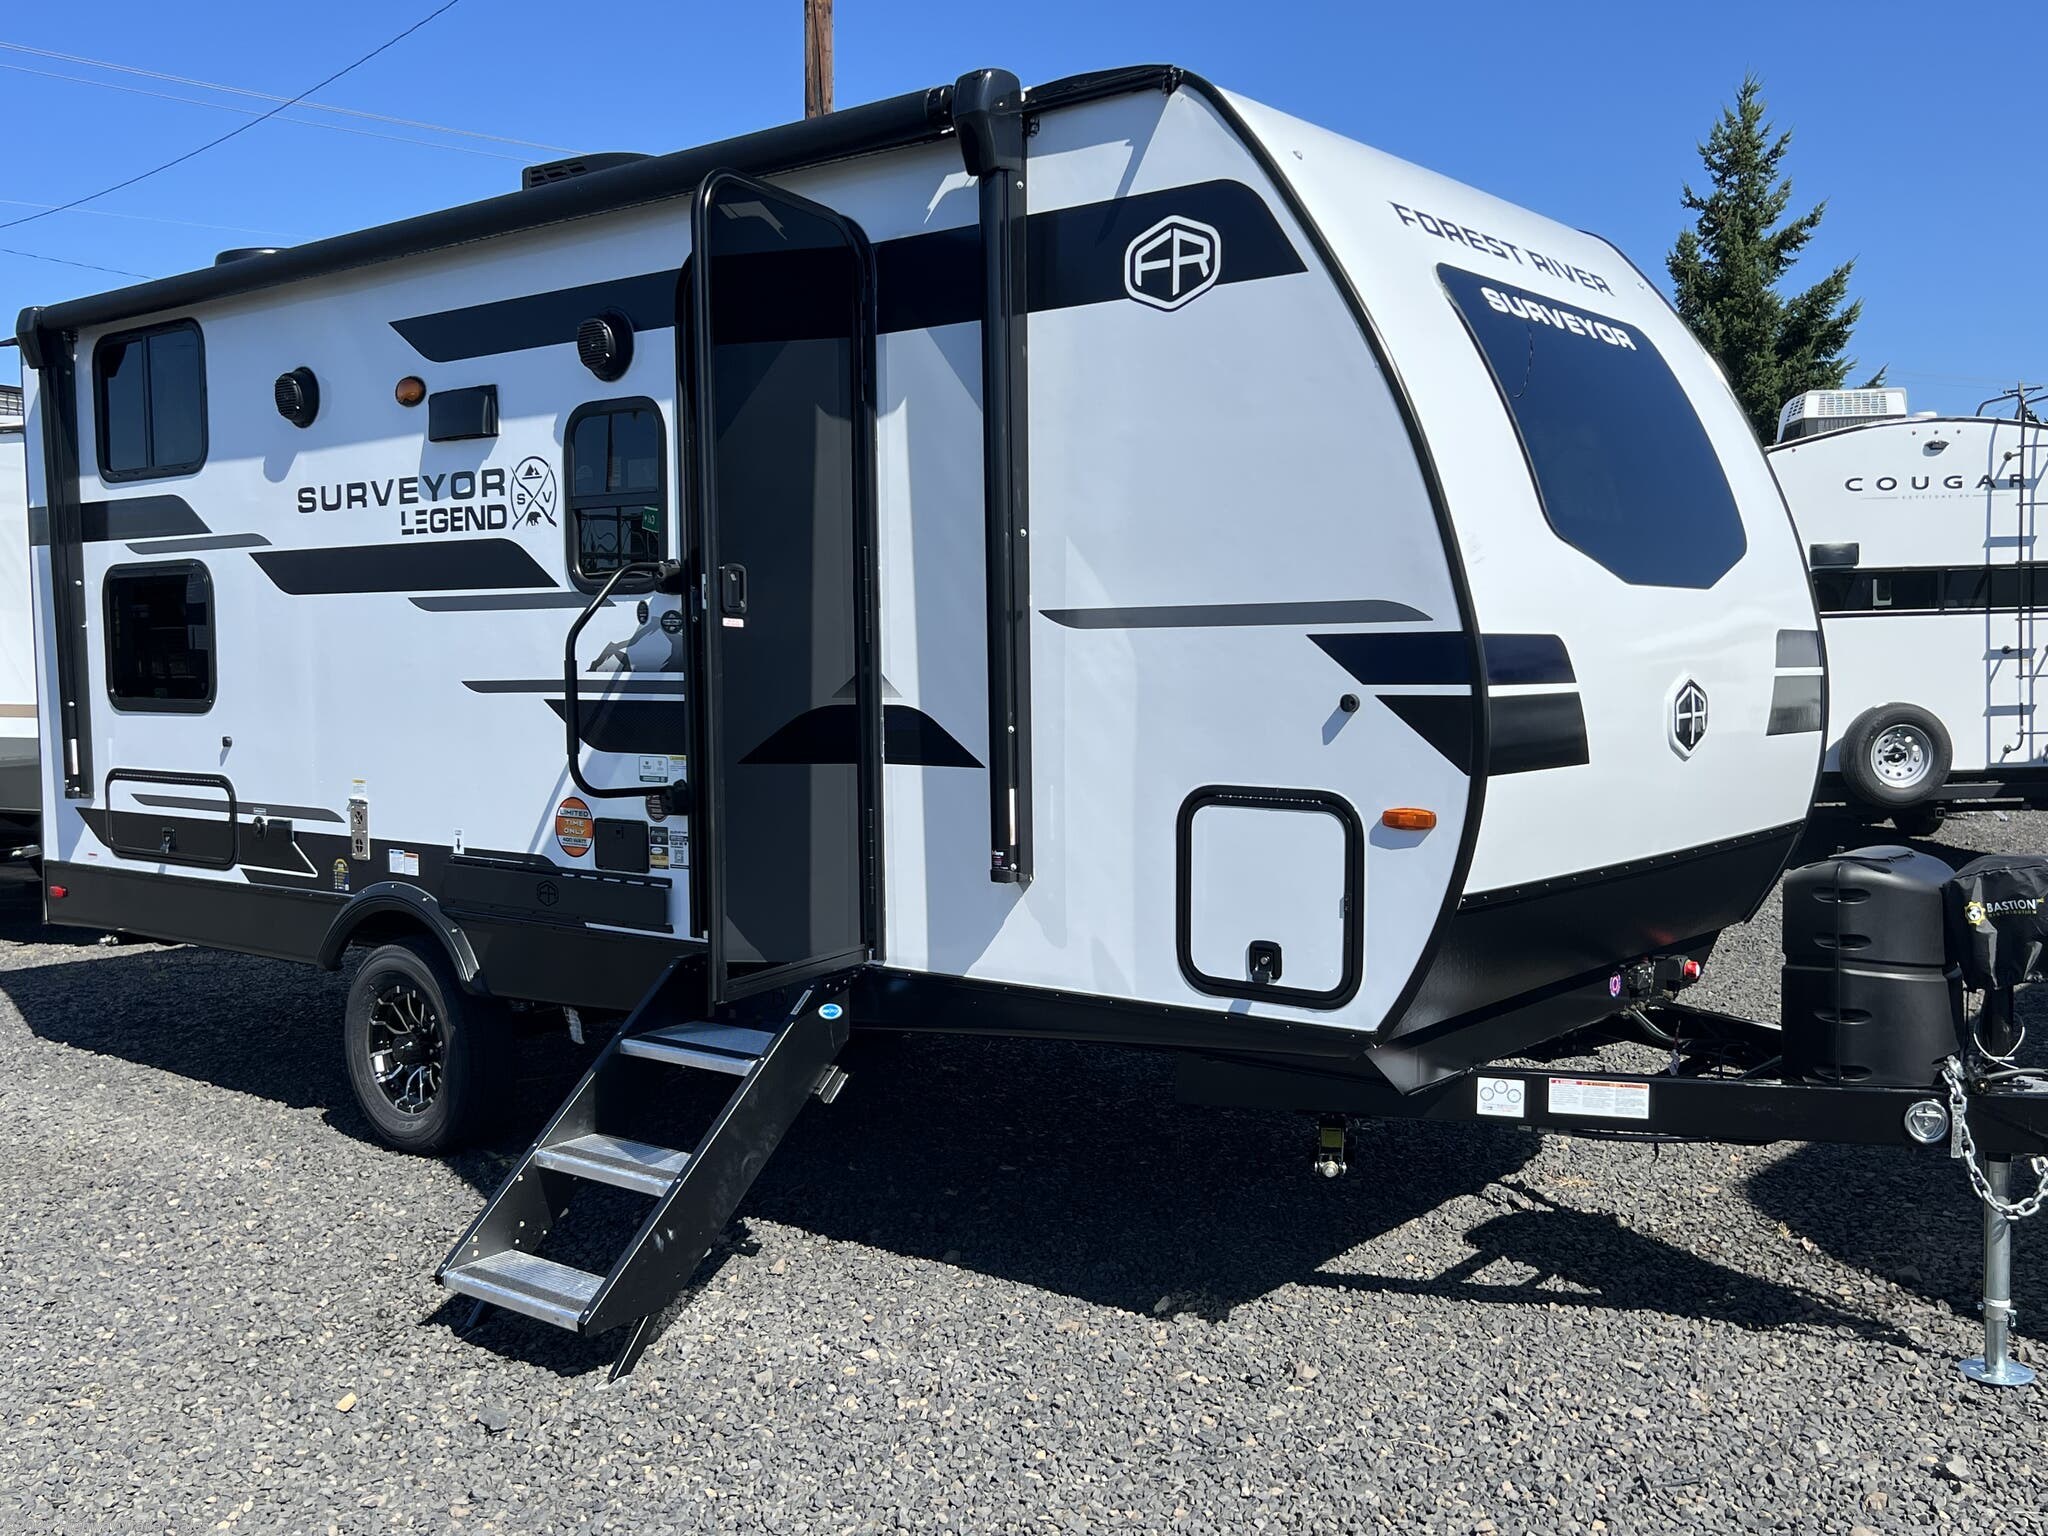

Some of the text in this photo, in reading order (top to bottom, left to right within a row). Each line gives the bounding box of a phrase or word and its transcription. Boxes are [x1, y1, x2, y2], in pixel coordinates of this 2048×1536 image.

[1388, 200, 1616, 297] FOREST RIVER
[1480, 286, 1637, 351] SURVEYOR
[297, 468, 506, 514] SURVEYOR
[1844, 473, 2027, 492] COUGAR
[401, 503, 508, 536] LEGEND
[560, 808, 589, 817] LIMITED
[563, 827, 586, 835] ONLY
[565, 819, 585, 827] TIME
[1986, 898, 2037, 913] BASTION
